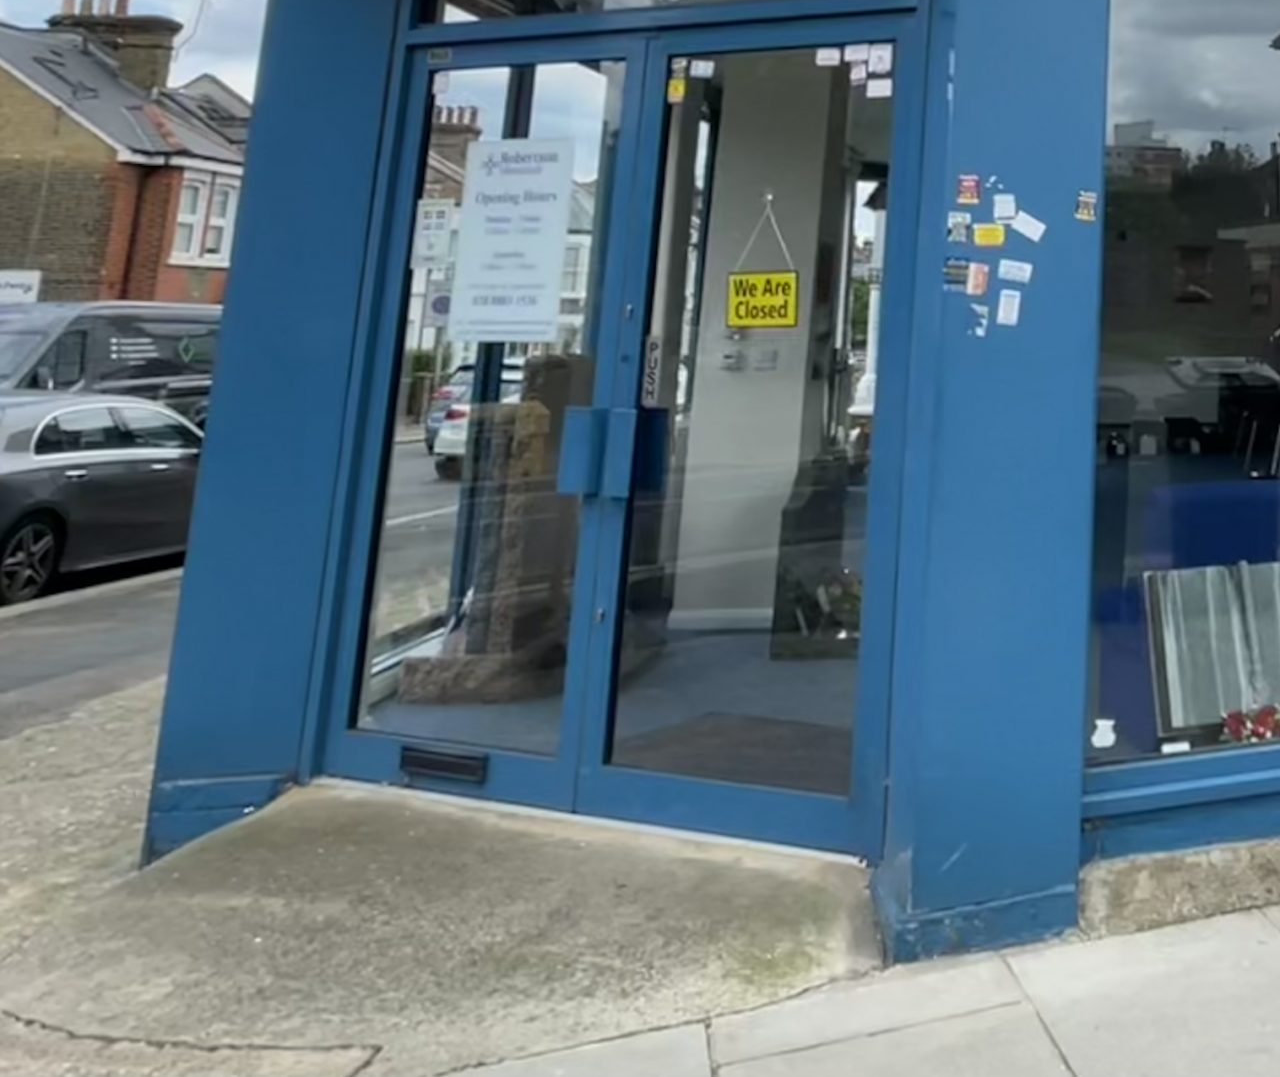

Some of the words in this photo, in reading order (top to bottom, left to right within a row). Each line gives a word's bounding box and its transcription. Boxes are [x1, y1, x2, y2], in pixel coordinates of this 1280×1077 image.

[733, 279, 759, 298] We
[763, 277, 791, 297] Are
[735, 299, 788, 320] Closed
[645, 341, 659, 400] PUSH
